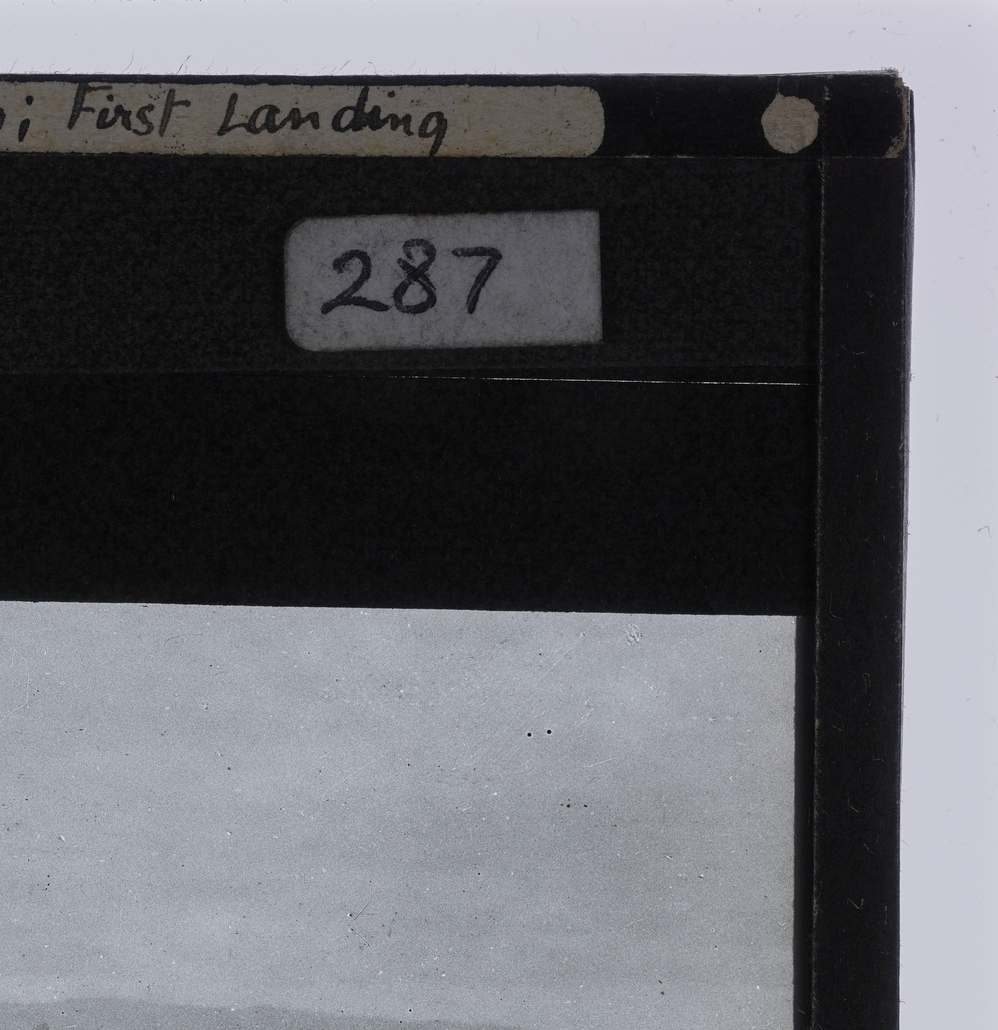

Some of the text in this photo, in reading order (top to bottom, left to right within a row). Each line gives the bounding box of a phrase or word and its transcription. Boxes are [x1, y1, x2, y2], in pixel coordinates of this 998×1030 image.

[66, 83, 191, 137] First
[216, 87, 448, 156] Landing
[320, 238, 502, 315] 287
